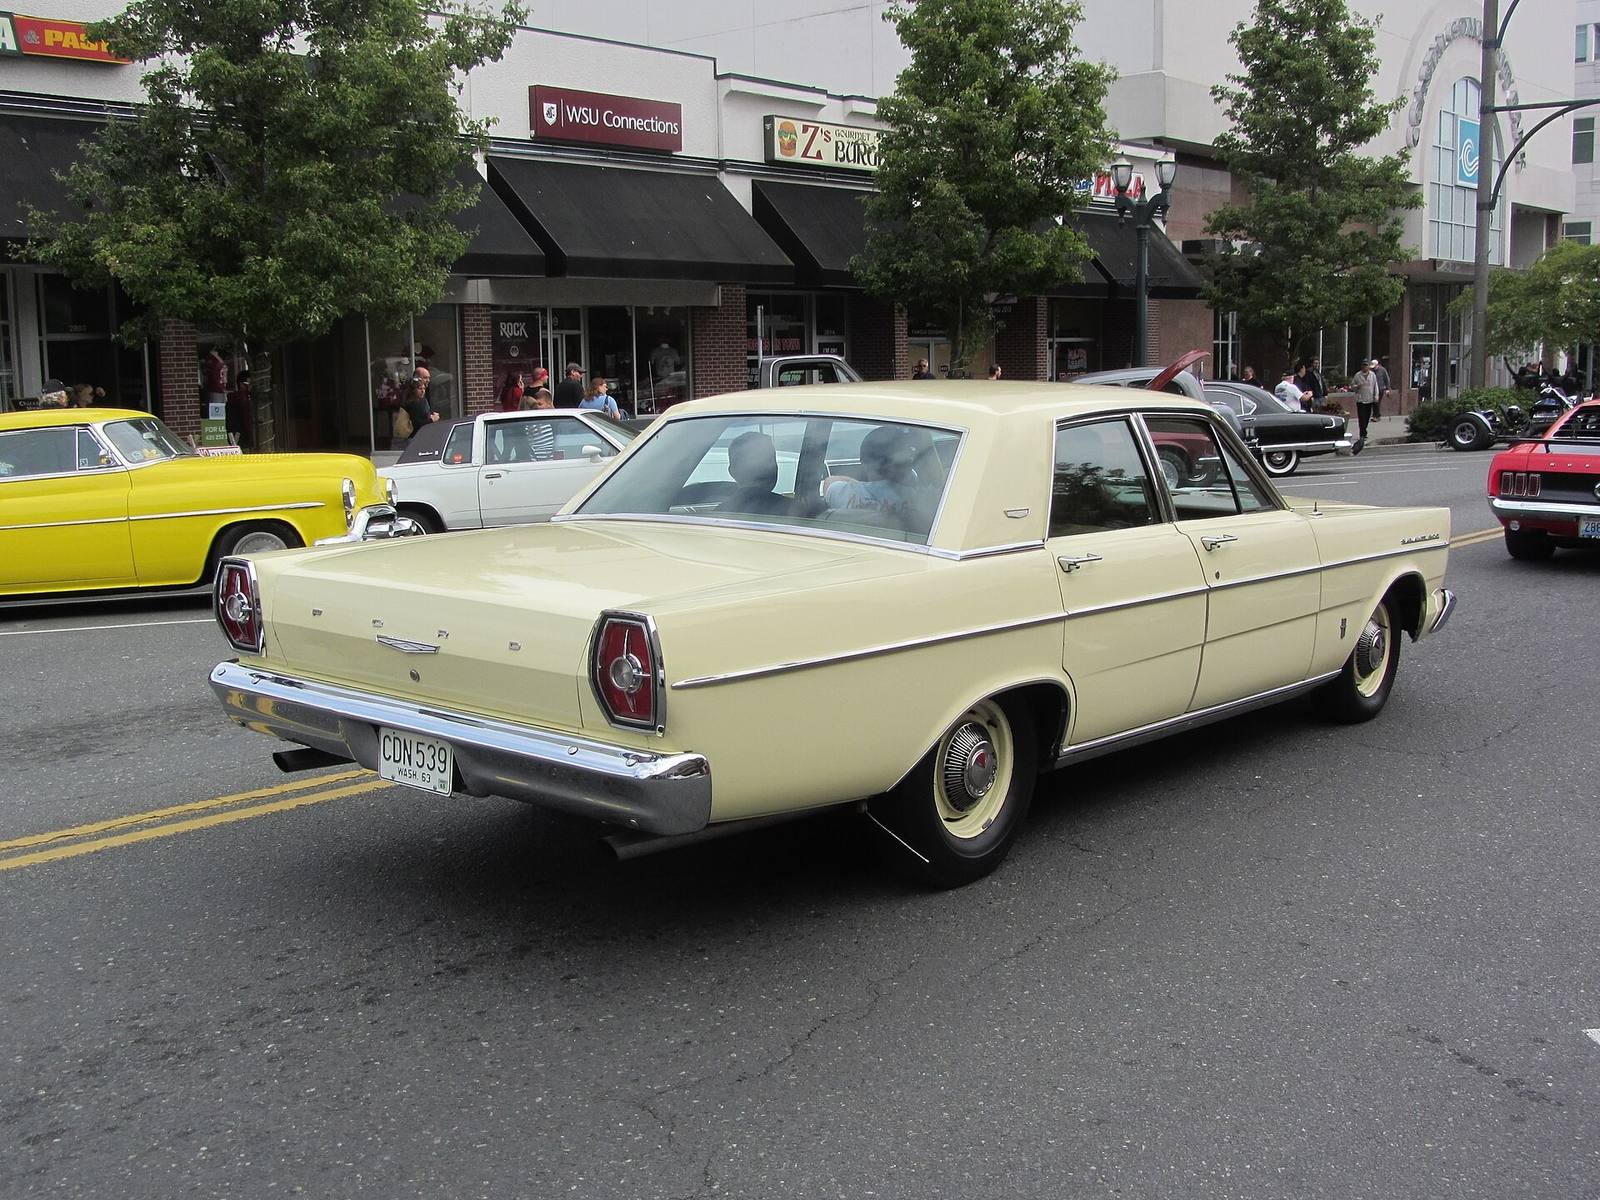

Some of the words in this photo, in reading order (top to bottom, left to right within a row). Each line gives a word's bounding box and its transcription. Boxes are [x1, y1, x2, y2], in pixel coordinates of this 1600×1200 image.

[566, 105, 599, 125] WSU
[603, 110, 679, 135] Connections
[835, 140, 887, 167] BURG
[500, 322, 528, 338] ROCK
[421, 772, 431, 783] 63
